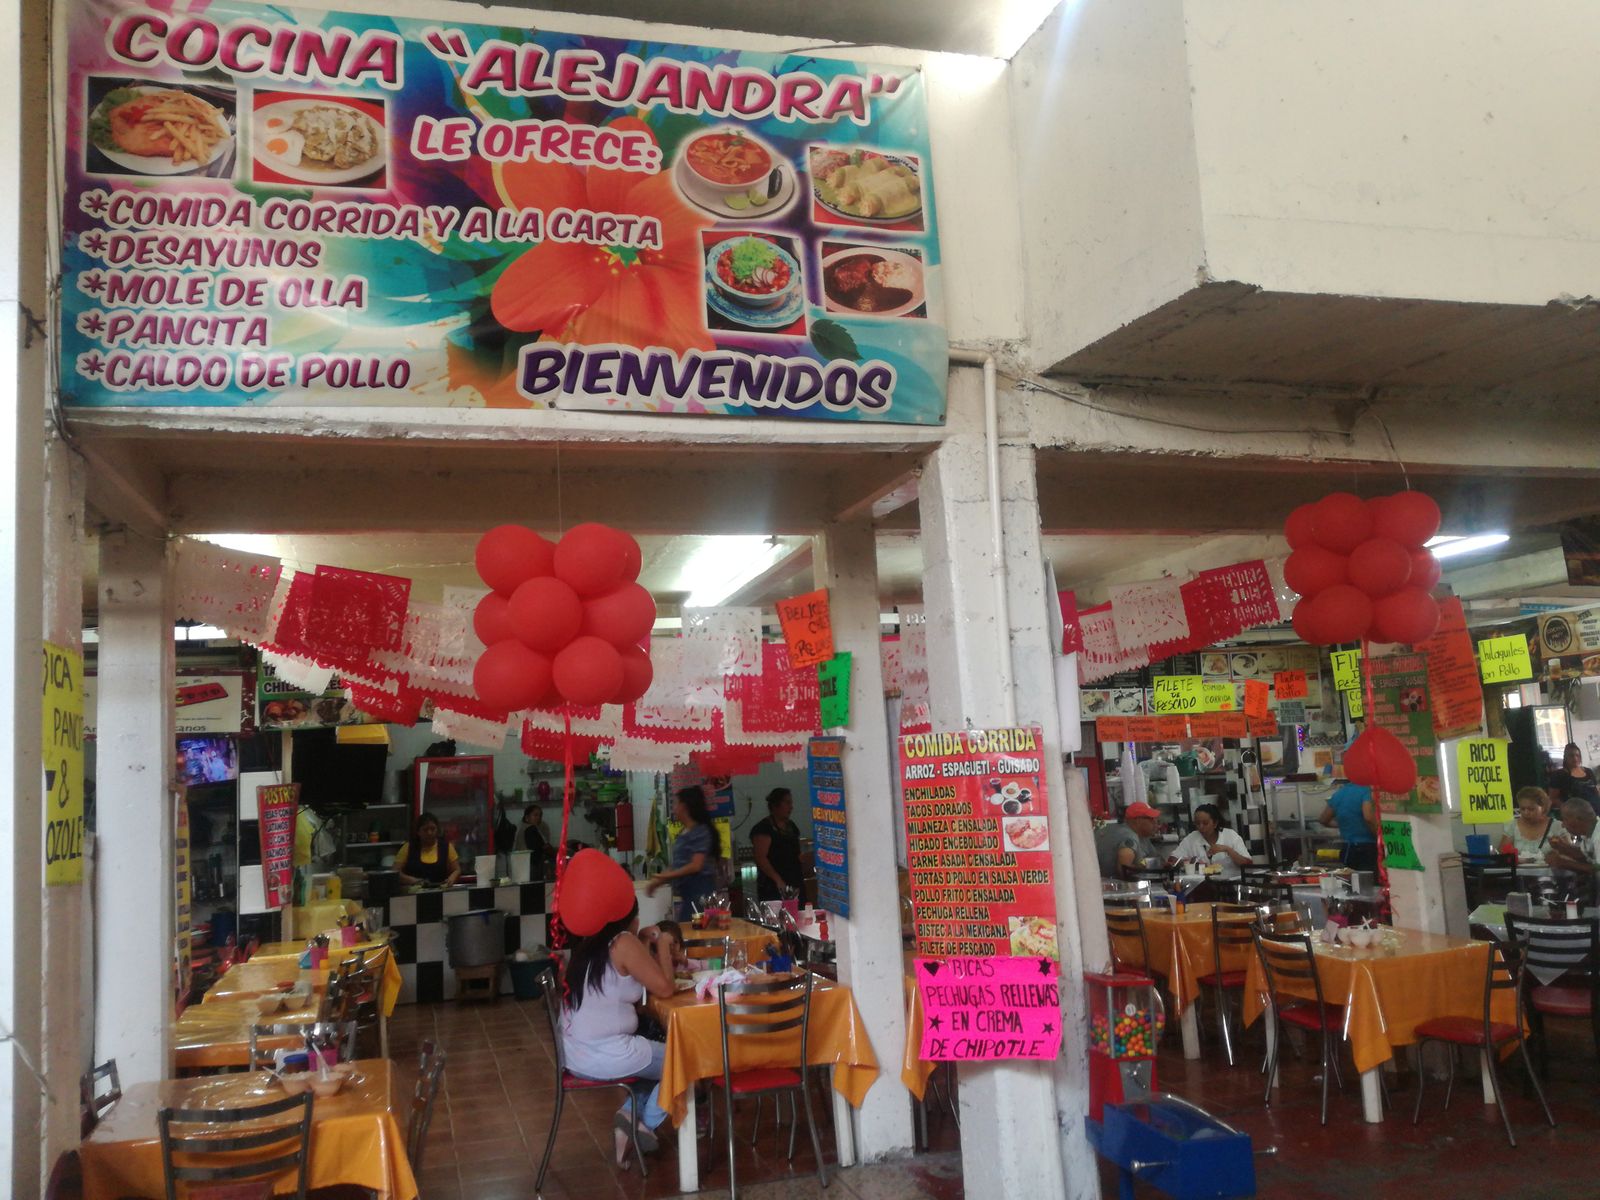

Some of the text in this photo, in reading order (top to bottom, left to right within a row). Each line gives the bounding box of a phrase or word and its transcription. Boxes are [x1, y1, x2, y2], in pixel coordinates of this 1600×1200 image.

[110, 14, 400, 86] COCINA
[416, 120, 659, 170] LE OFRECE:
[264, 202, 421, 236] CORRIDA
[431, 211, 456, 238] Y
[465, 214, 490, 239] A
[500, 213, 543, 241] LA
[551, 213, 659, 246] CARTA
[219, 277, 269, 307] DE
[278, 278, 364, 309] OLLA
[240, 355, 288, 387] DE
[301, 356, 411, 389] POLLO
[522, 346, 896, 411] BIENVENIDOS
[1499, 663, 1521, 677] Pollo
[1155, 677, 1194, 692] FILETE
[1156, 696, 1197, 712] PESCADO
[1204, 694, 1232, 704] CORRIDA
[904, 727, 1037, 759] COMIDA CORRIDA
[1469, 743, 1496, 763] RICO
[905, 757, 1040, 780] ARROZ ESPAGUETI GUISADO
[1467, 765, 1503, 783] POZOLE
[58, 759, 70, 810] &
[904, 785, 956, 801] ENCHILADAS
[1482, 782, 1490, 794] Y
[906, 802, 973, 818] TACOS DORADOS
[1469, 794, 1507, 812] PANCITA
[907, 819, 949, 835] MILANEZA
[909, 835, 999, 852] HIGADO ENCEBOLLADO
[1386, 841, 1407, 857] Olla
[911, 854, 939, 868] CARNE
[940, 853, 967, 868] ASADA
[912, 871, 944, 886] TORTAS
[978, 870, 989, 885] EN
[991, 870, 1019, 885] SALSA
[1020, 869, 1049, 884] VERDE
[914, 888, 941, 903] POLLO
[943, 888, 965, 903] FRITO
[916, 906, 990, 921] PECHUGA RELLENA
[918, 922, 1008, 939] BISTEC A LA MEXICANA
[918, 941, 996, 957] FILETE DE PESCADO
[952, 959, 995, 978] RICAS
[925, 983, 1060, 1008] PECHUGAS RELLENAS
[951, 1009, 1024, 1034] EN CREMA
[929, 1037, 1047, 1059] DE CHIPOTLE
